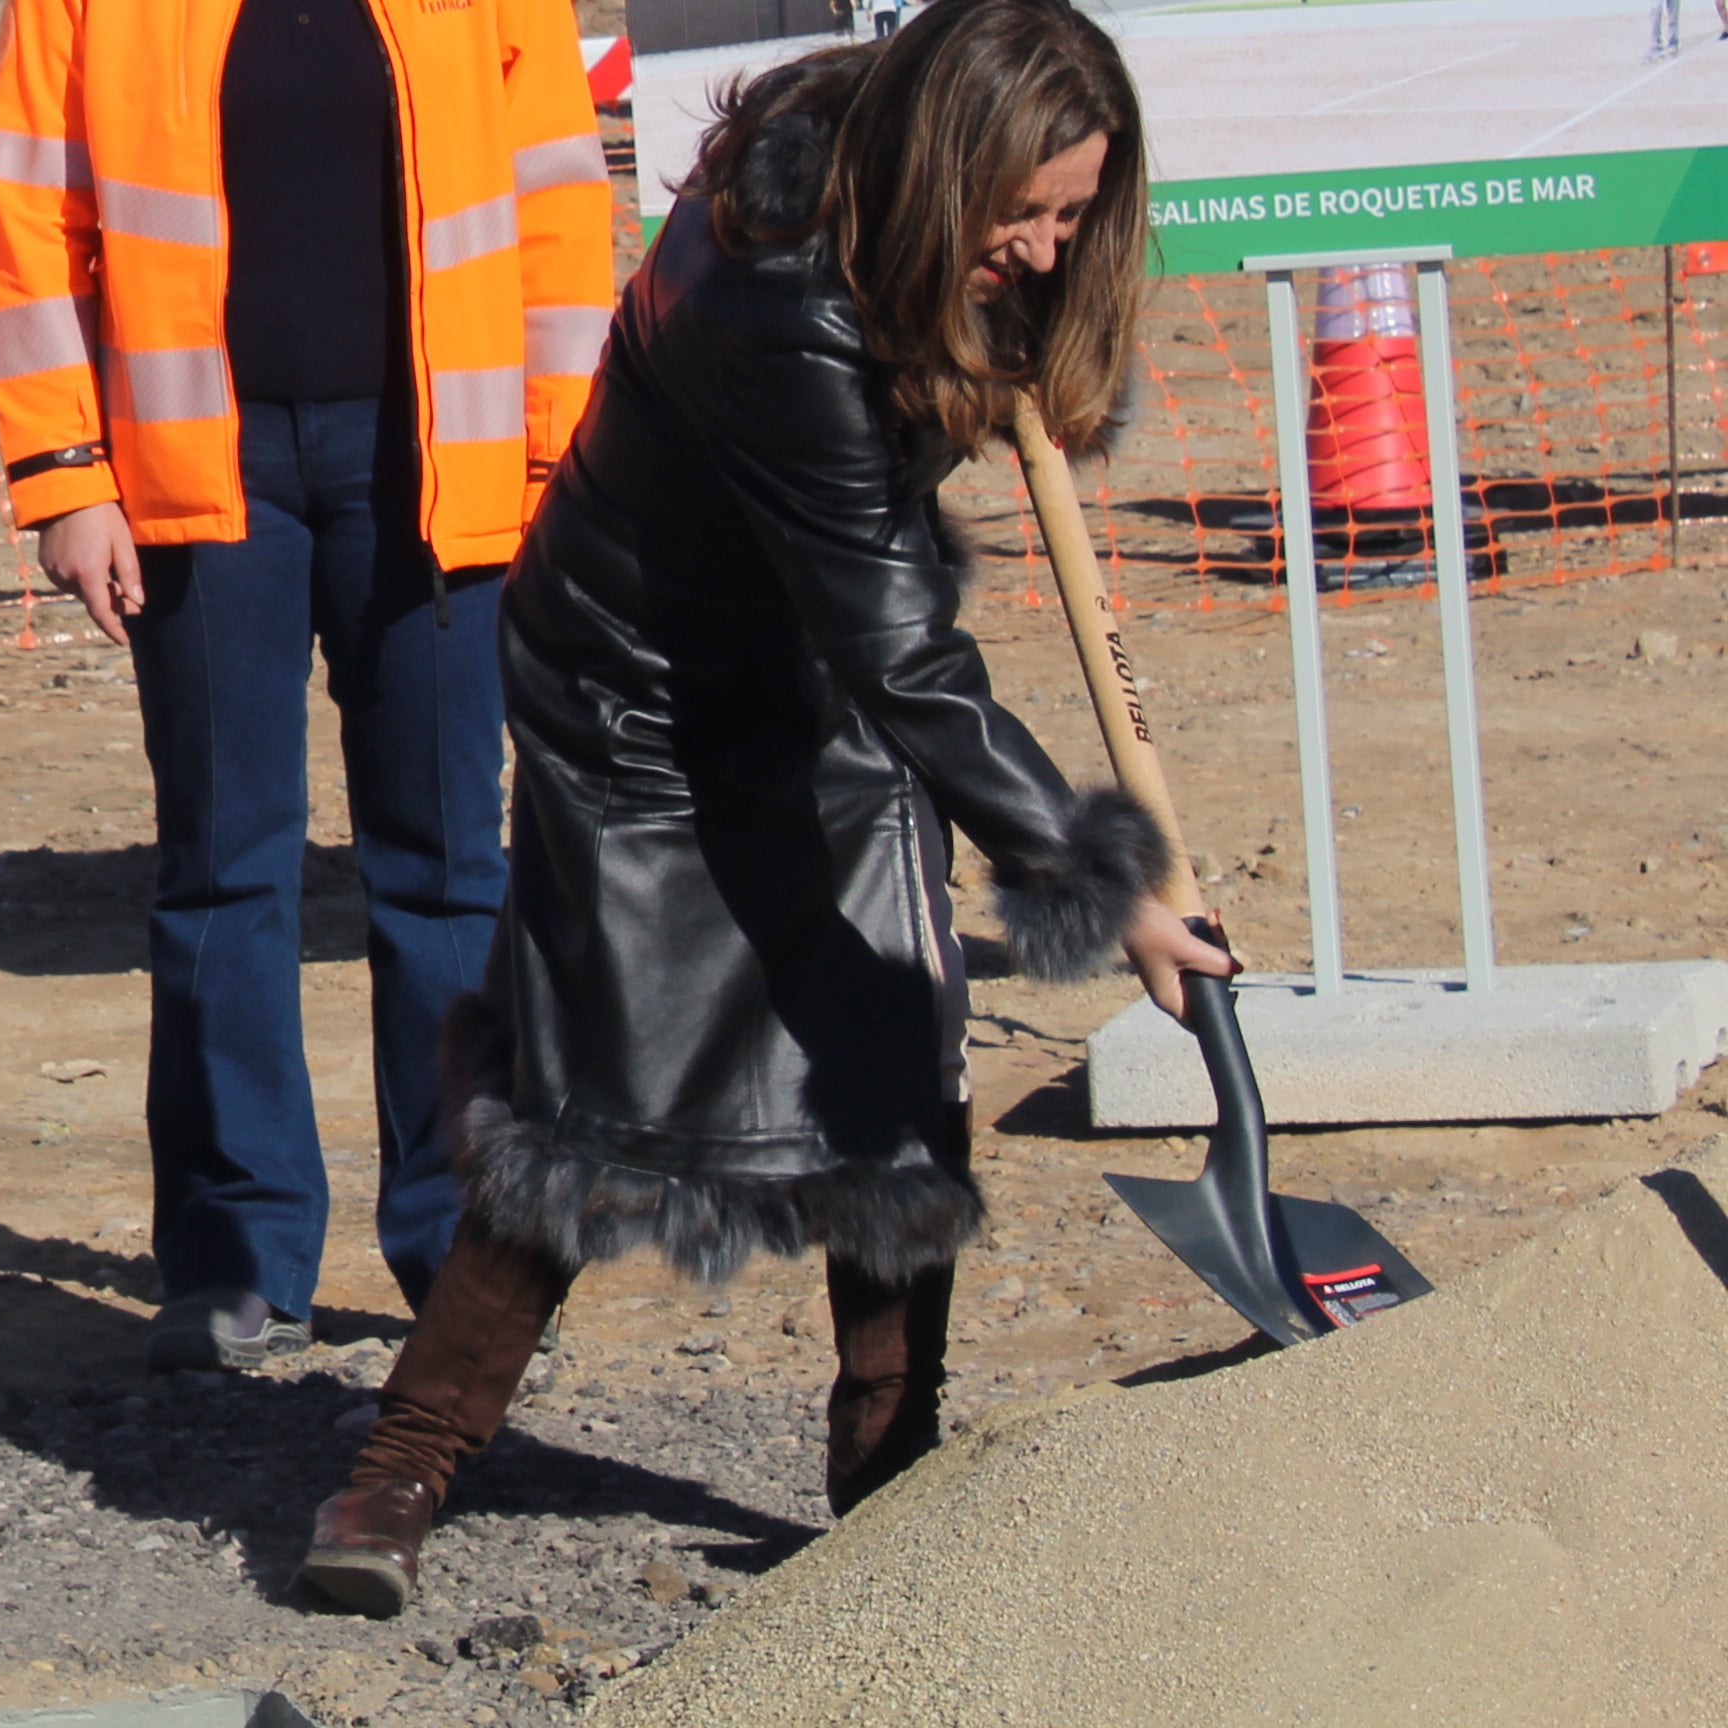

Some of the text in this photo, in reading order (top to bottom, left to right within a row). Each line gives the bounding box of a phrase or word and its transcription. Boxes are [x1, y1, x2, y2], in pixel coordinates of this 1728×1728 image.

[1147, 174, 1596, 227] SALINAS DE ROQUETAS DE MAR
[1106, 632, 1153, 745] BELLOTA
